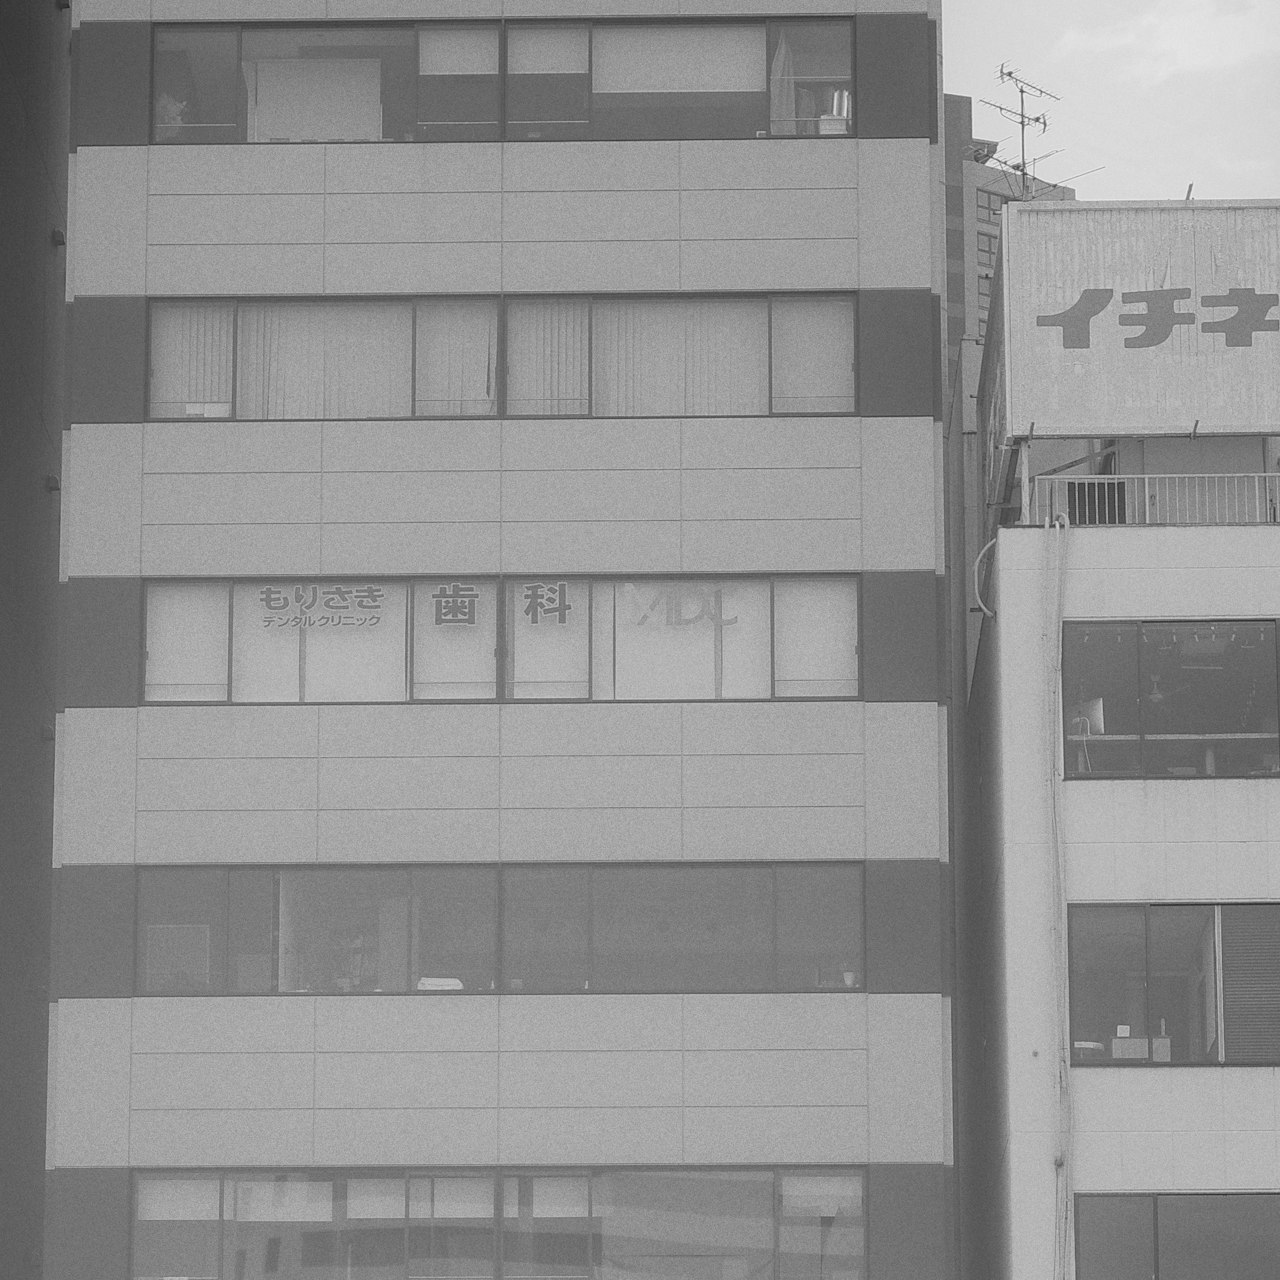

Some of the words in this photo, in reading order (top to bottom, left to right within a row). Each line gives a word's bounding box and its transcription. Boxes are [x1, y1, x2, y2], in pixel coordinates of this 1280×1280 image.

[259, 585, 385, 611] もりさき
[263, 615, 381, 628] デンタルクリニック
